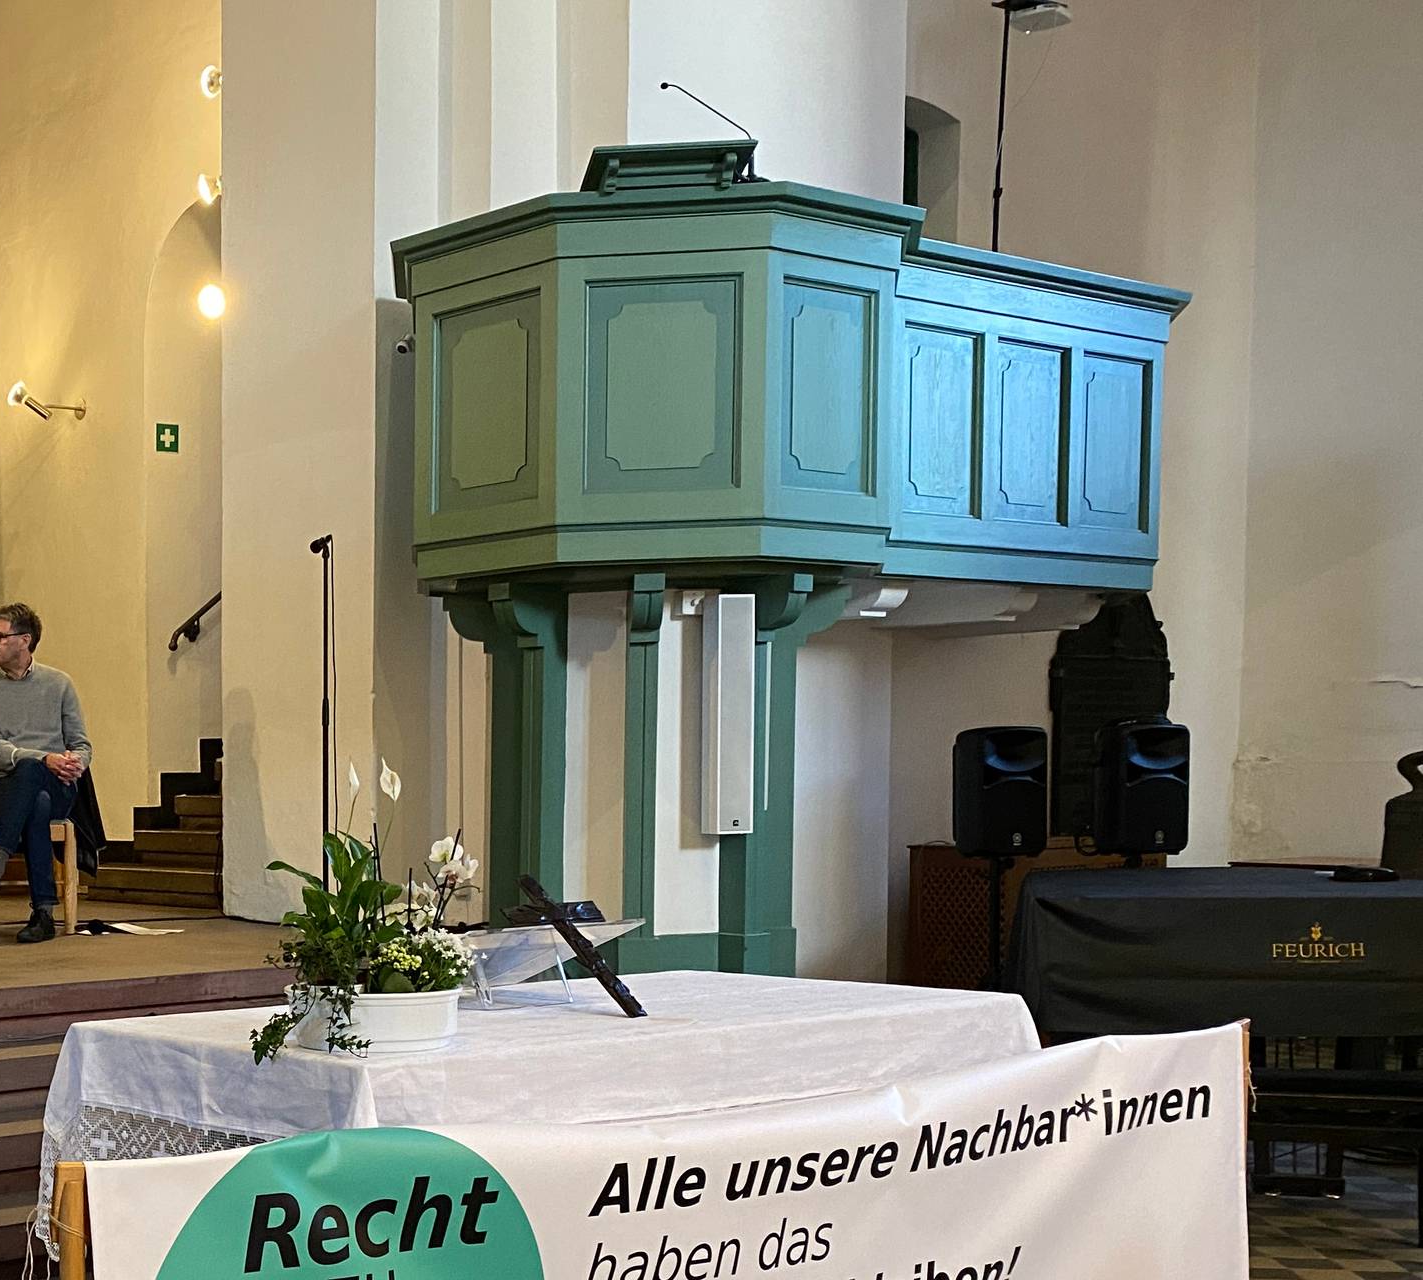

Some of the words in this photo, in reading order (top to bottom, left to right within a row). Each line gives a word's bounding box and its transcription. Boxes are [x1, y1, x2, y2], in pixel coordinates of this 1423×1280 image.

[1272, 942, 1366, 958] FEURICH
[587, 1155, 707, 1217] Alle
[725, 1141, 899, 1202] unsere
[244, 1176, 500, 1274] Recht
[586, 1235, 741, 1280] haben
[758, 1217, 833, 1271] das
